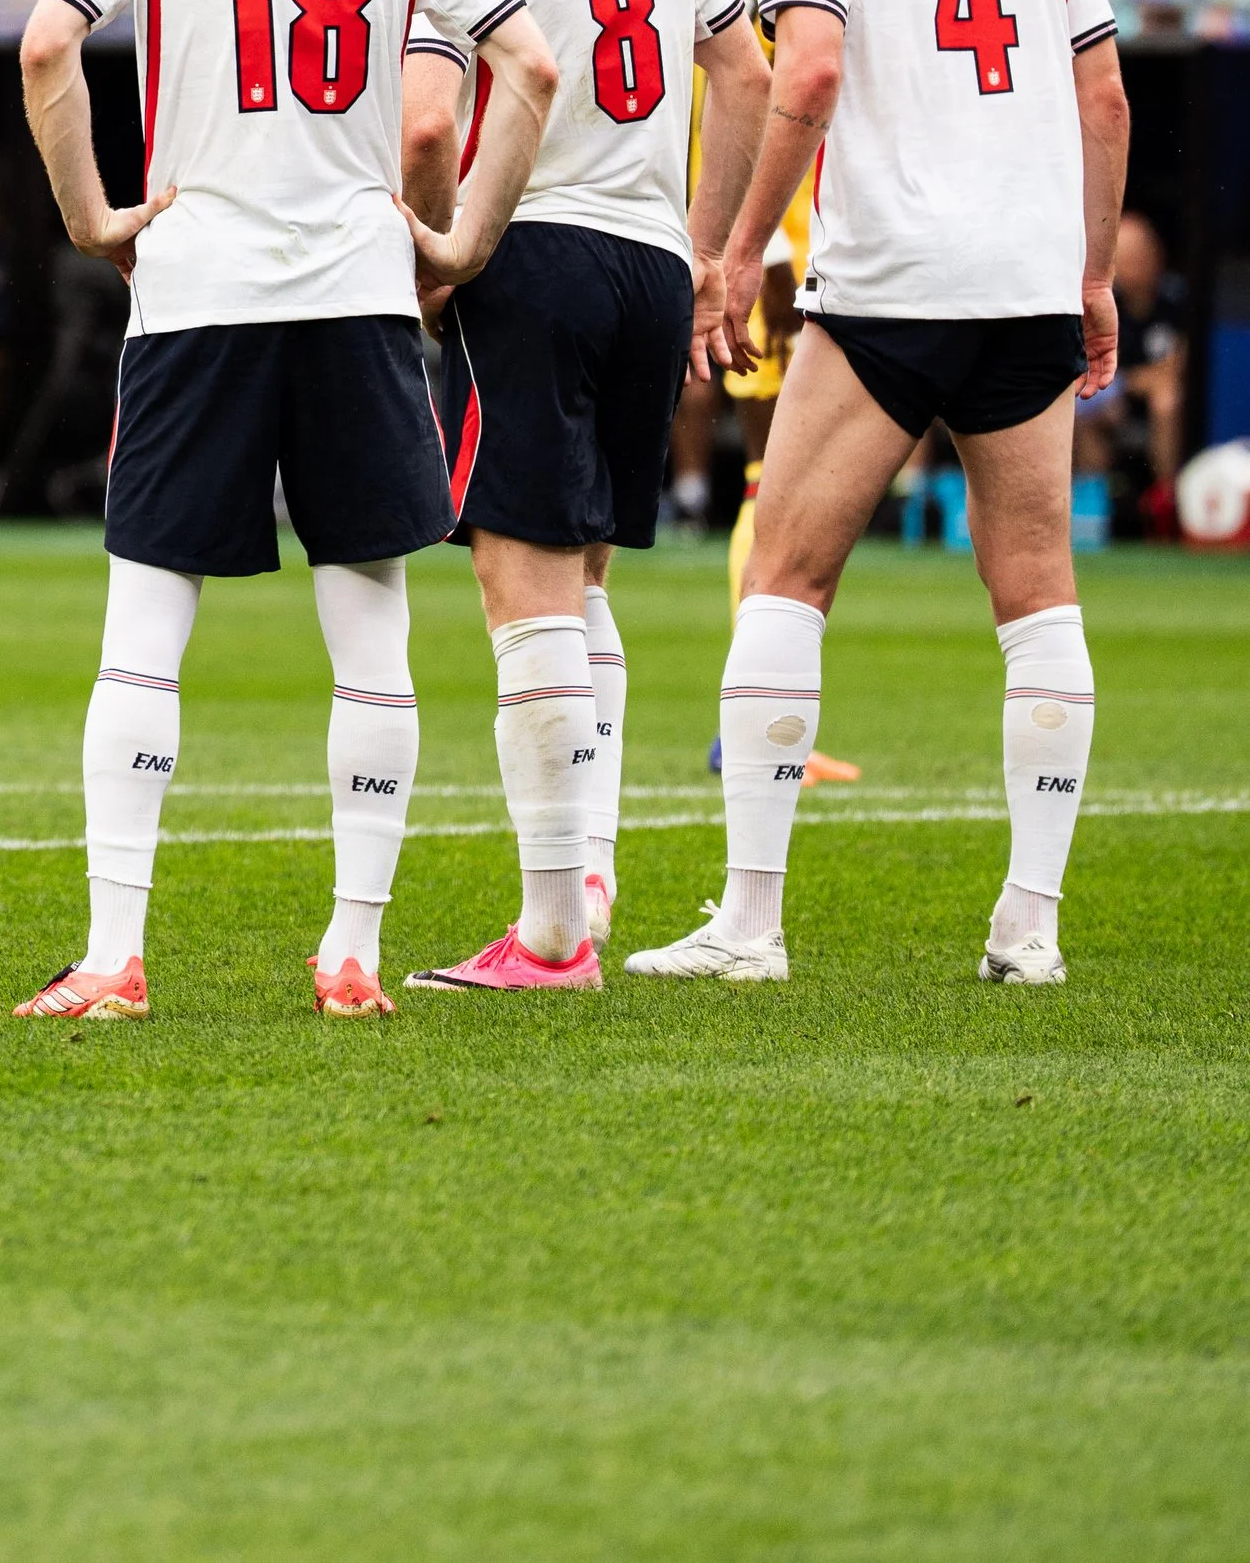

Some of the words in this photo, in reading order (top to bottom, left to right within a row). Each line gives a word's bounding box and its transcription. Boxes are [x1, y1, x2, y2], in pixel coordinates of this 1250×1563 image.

[132, 752, 174, 773] ENG
[774, 764, 805, 781] ENG
[351, 775, 398, 796] ENG
[1036, 775, 1077, 794] ENG
